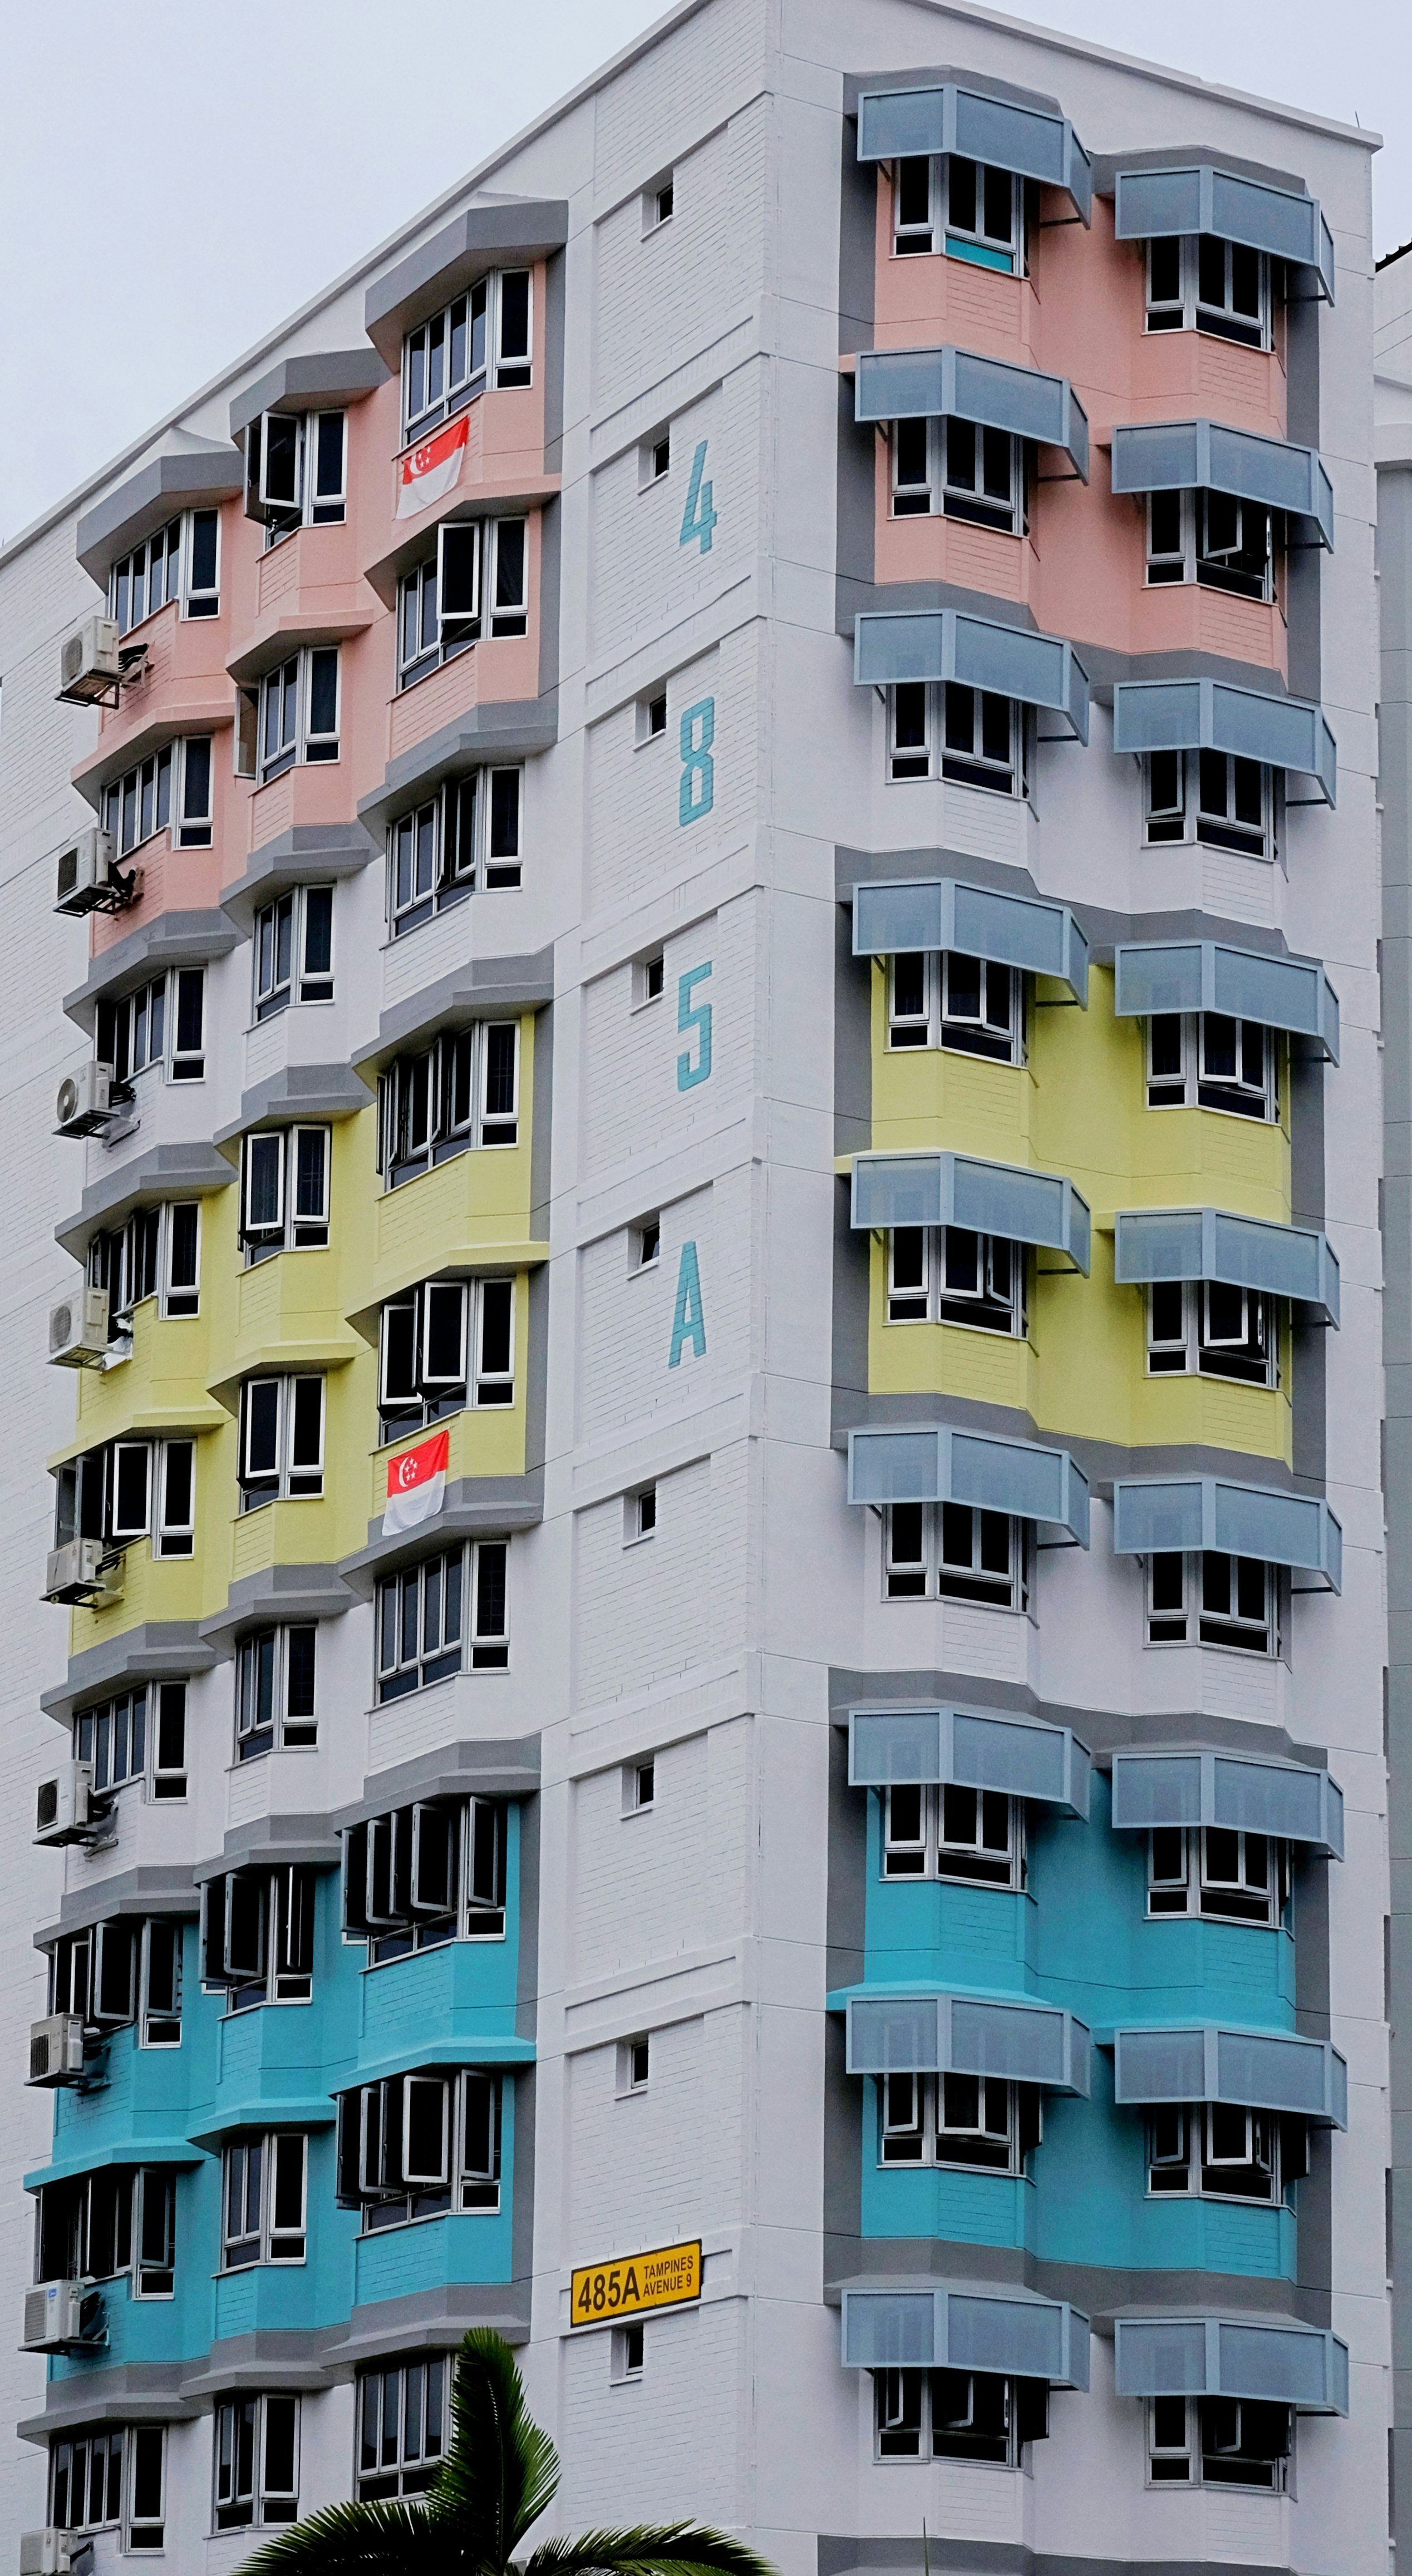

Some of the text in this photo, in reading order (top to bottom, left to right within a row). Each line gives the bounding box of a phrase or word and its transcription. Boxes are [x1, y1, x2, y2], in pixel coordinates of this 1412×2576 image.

[643, 2255, 693, 2279] TAMPINES
[578, 2267, 640, 2313] 485A
[643, 2273, 692, 2297] AVENUE 9
